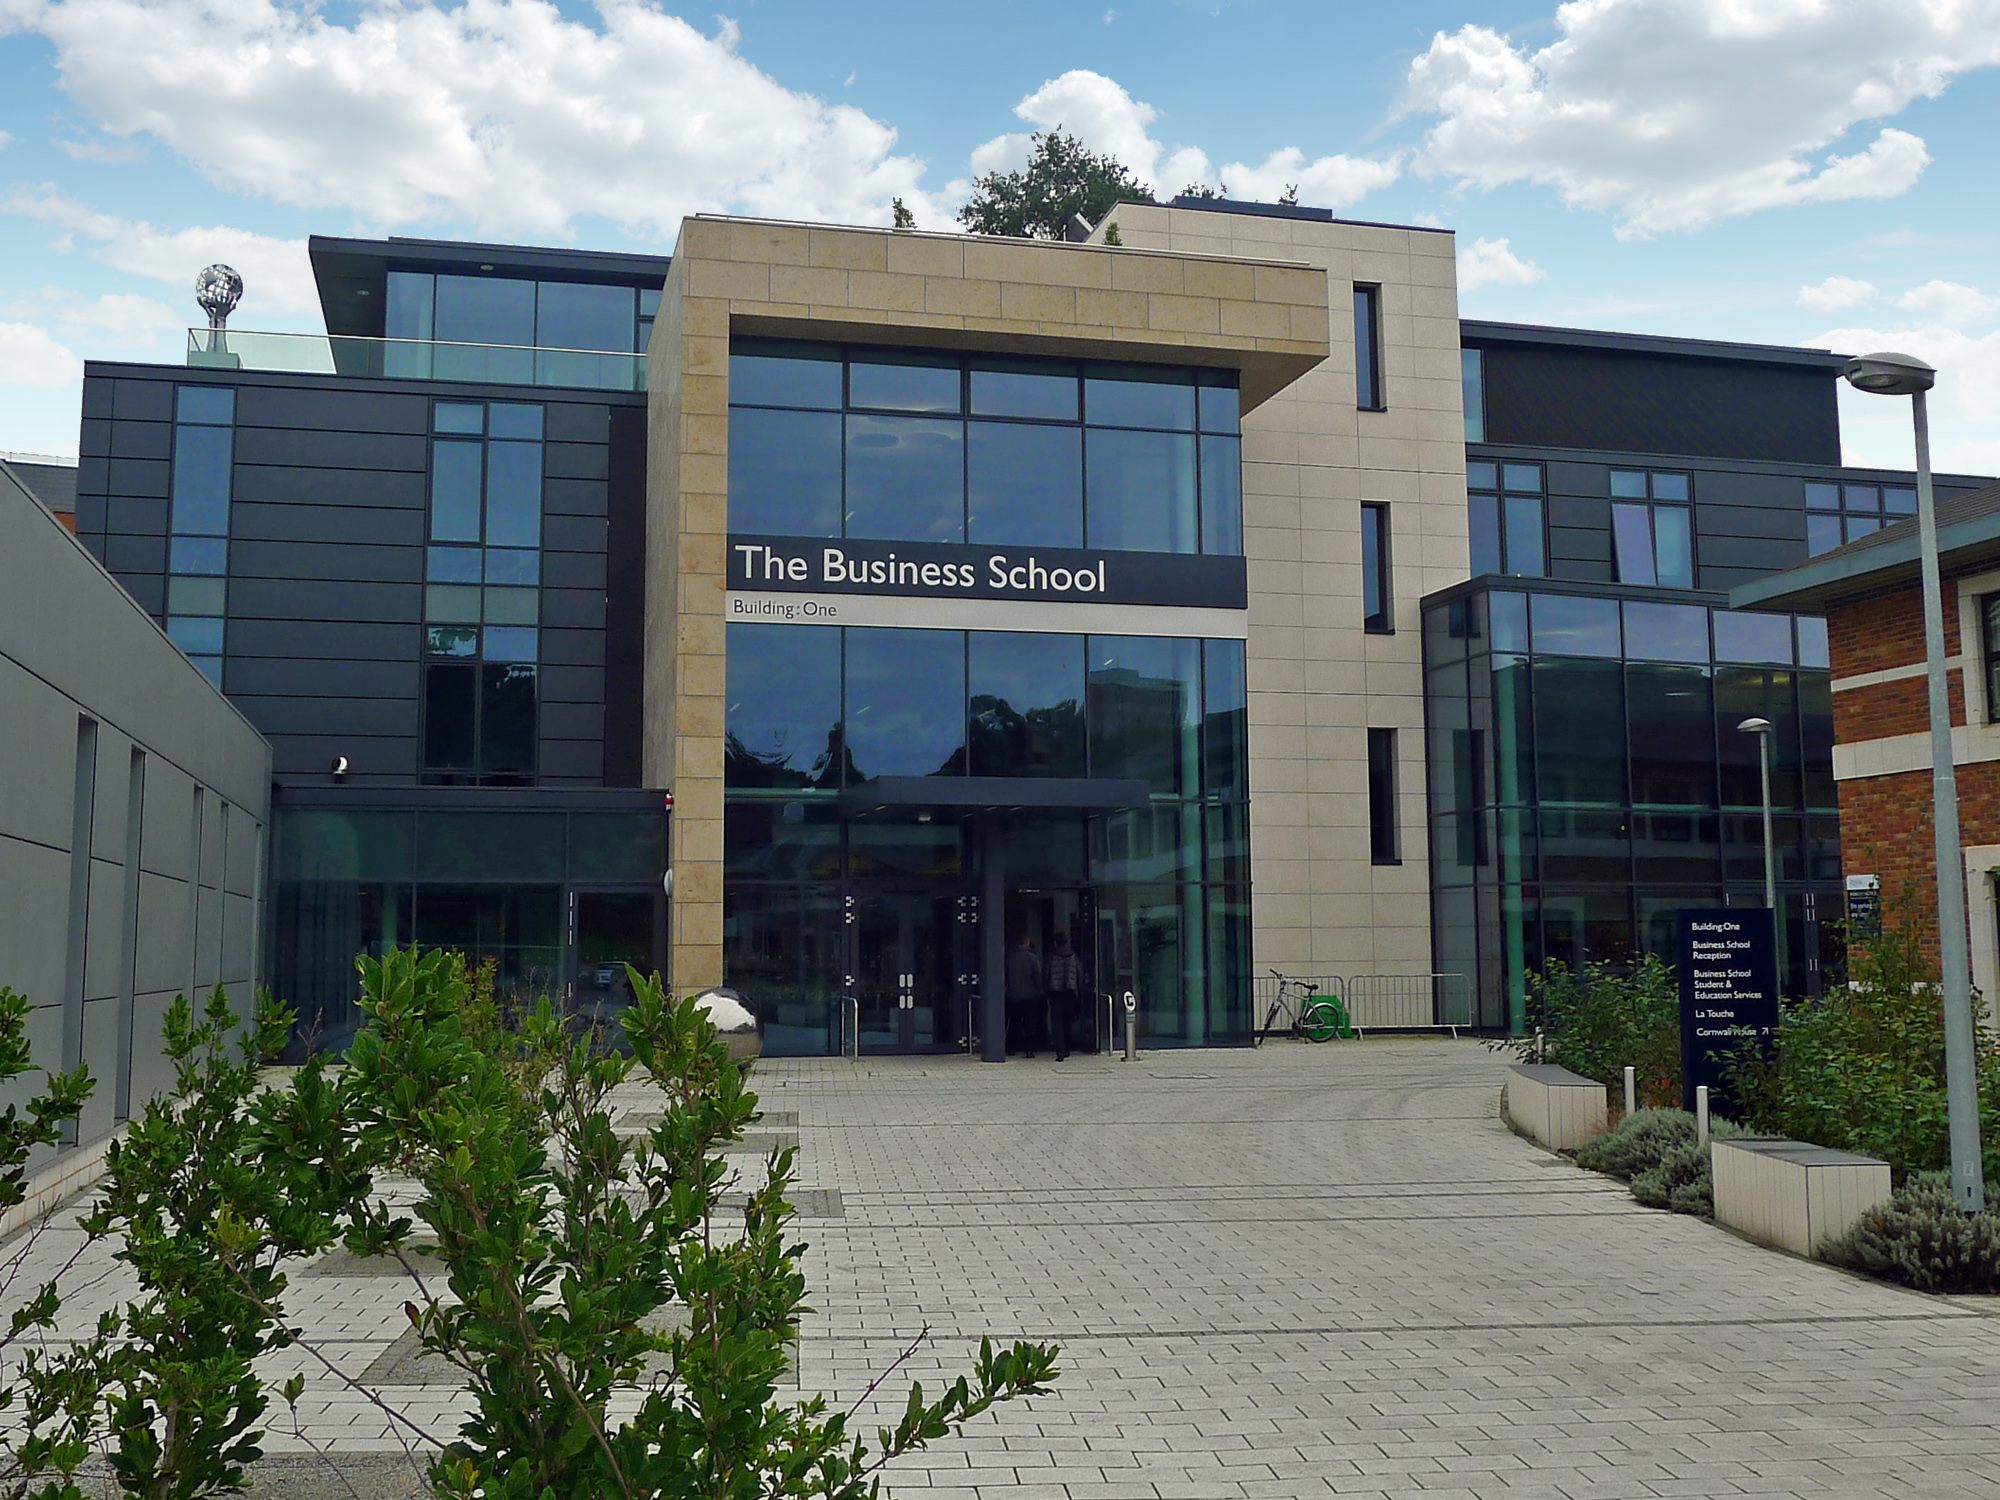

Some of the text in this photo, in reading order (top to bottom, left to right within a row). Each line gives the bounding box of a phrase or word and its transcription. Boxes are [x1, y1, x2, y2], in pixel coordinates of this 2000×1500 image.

[735, 544, 1106, 593] The Business School
[1692, 939, 1751, 949] Business School
[1692, 951, 1732, 962] Reception
[1693, 968, 1752, 978] Business School
[1694, 979, 1732, 989] Student &
[1694, 990, 1763, 1000] Education Services
[1695, 1008, 1735, 1018] La Touche
